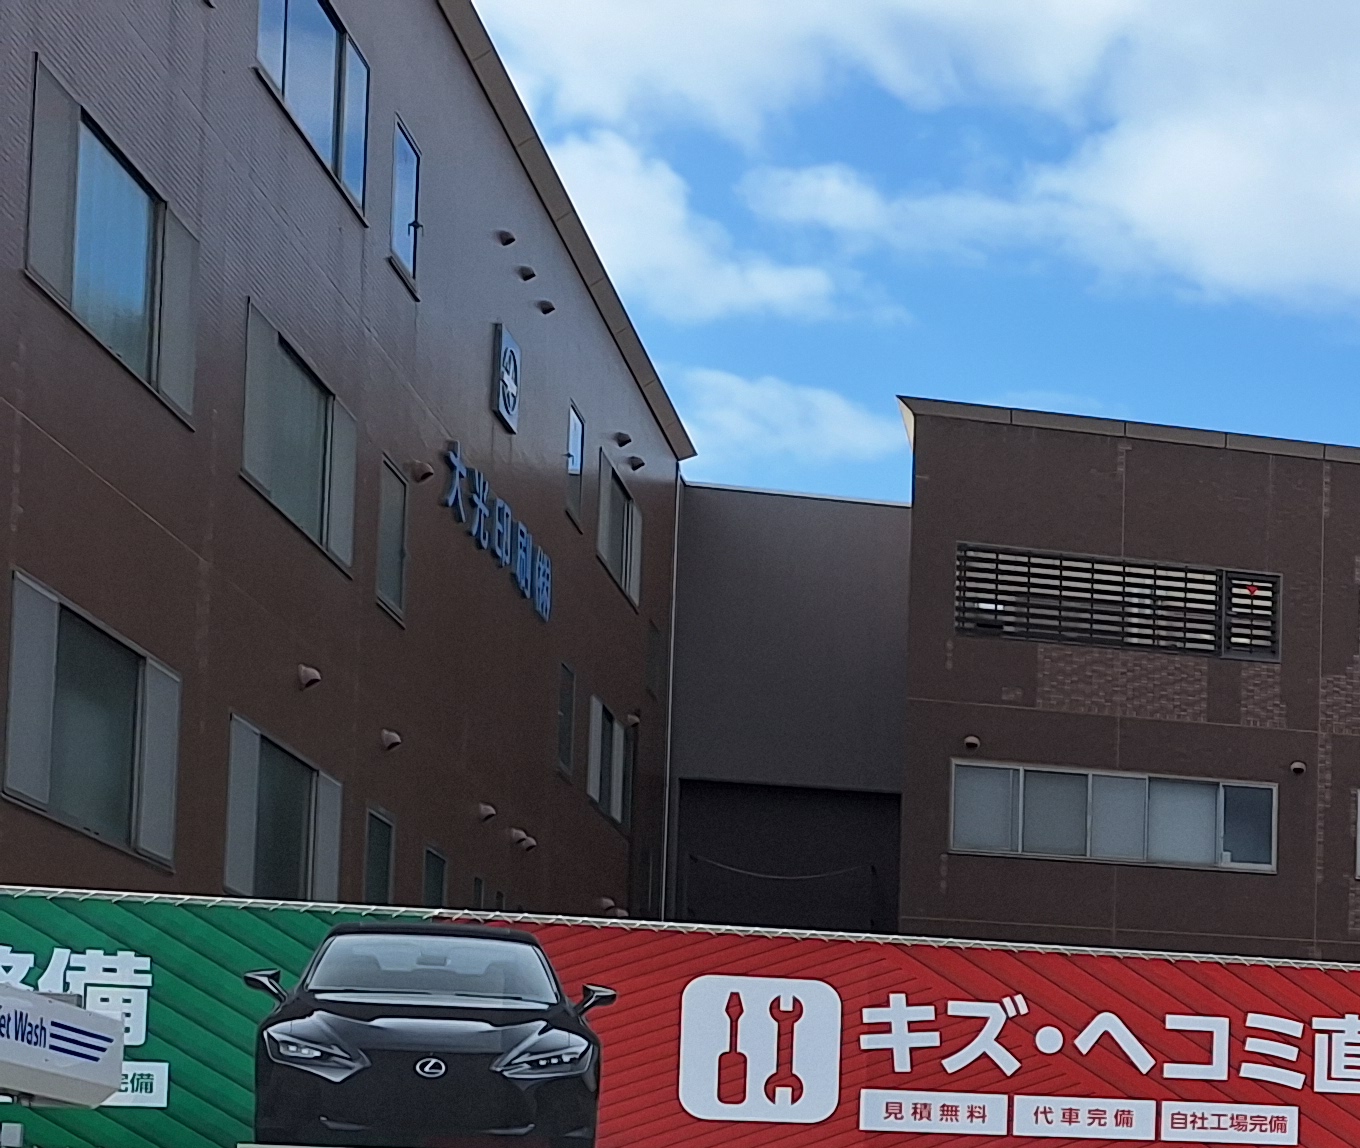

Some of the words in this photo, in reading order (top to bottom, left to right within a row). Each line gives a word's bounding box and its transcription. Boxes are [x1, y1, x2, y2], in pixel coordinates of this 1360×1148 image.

[0, 945, 153, 1046] 備
[14, 1009, 47, 1049] Wash
[882, 1101, 989, 1125] 見積無料
[1033, 1106, 1135, 1129] 代車完備
[1170, 1111, 1289, 1135] 自社工場完備
